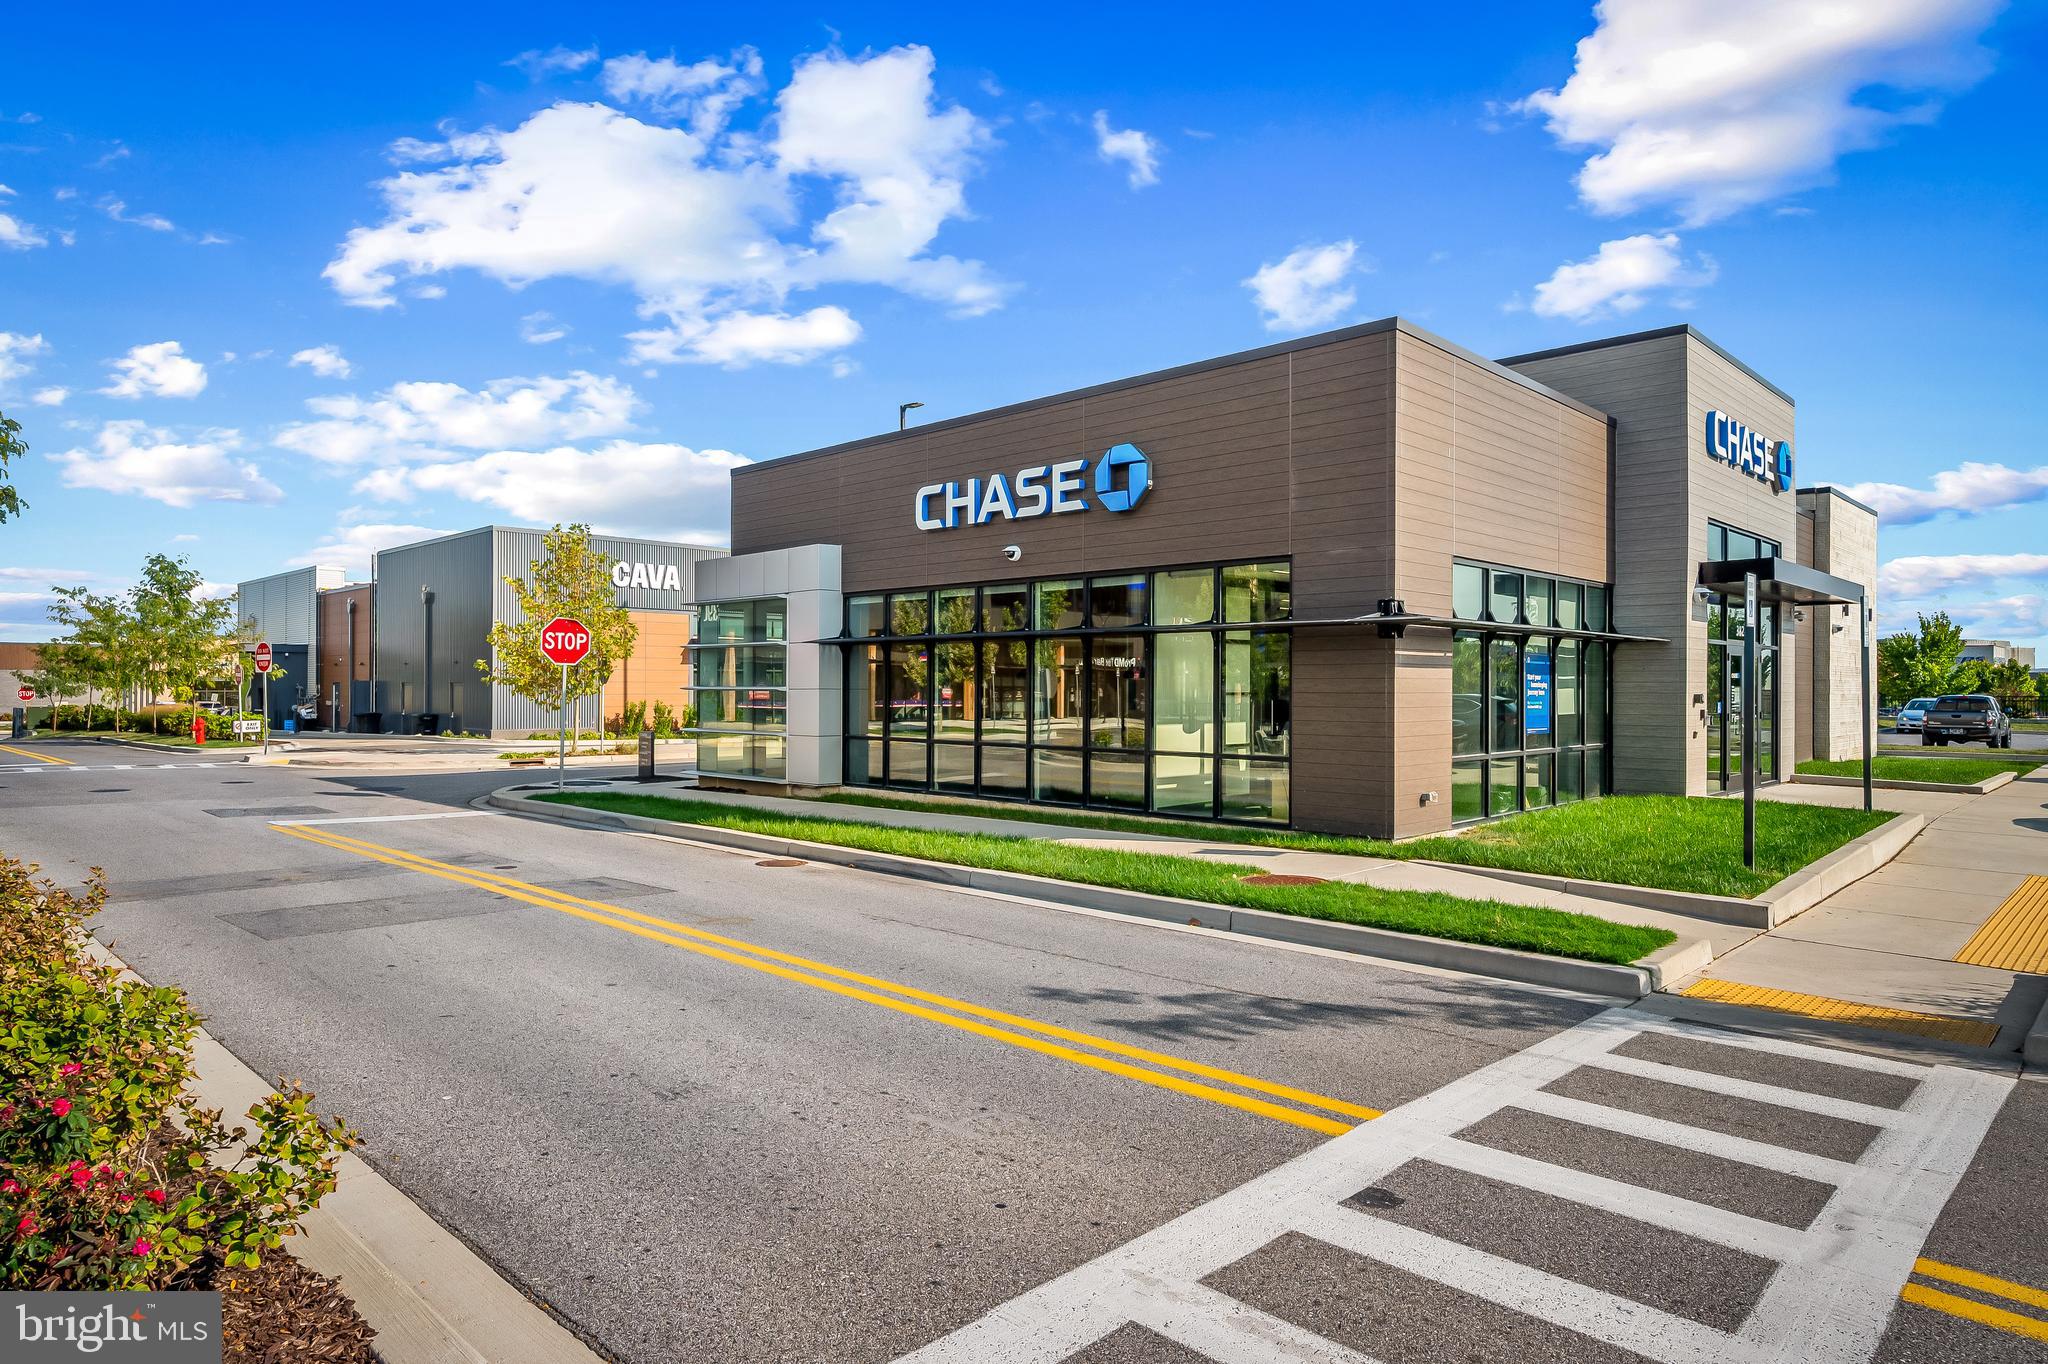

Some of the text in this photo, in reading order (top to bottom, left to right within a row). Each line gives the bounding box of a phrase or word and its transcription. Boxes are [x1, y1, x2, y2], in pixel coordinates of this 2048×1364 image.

[1706, 409, 1775, 483] CHASE
[915, 459, 1090, 531] CHASE
[612, 561, 681, 591] CAVA
[544, 631, 587, 650] STOP
